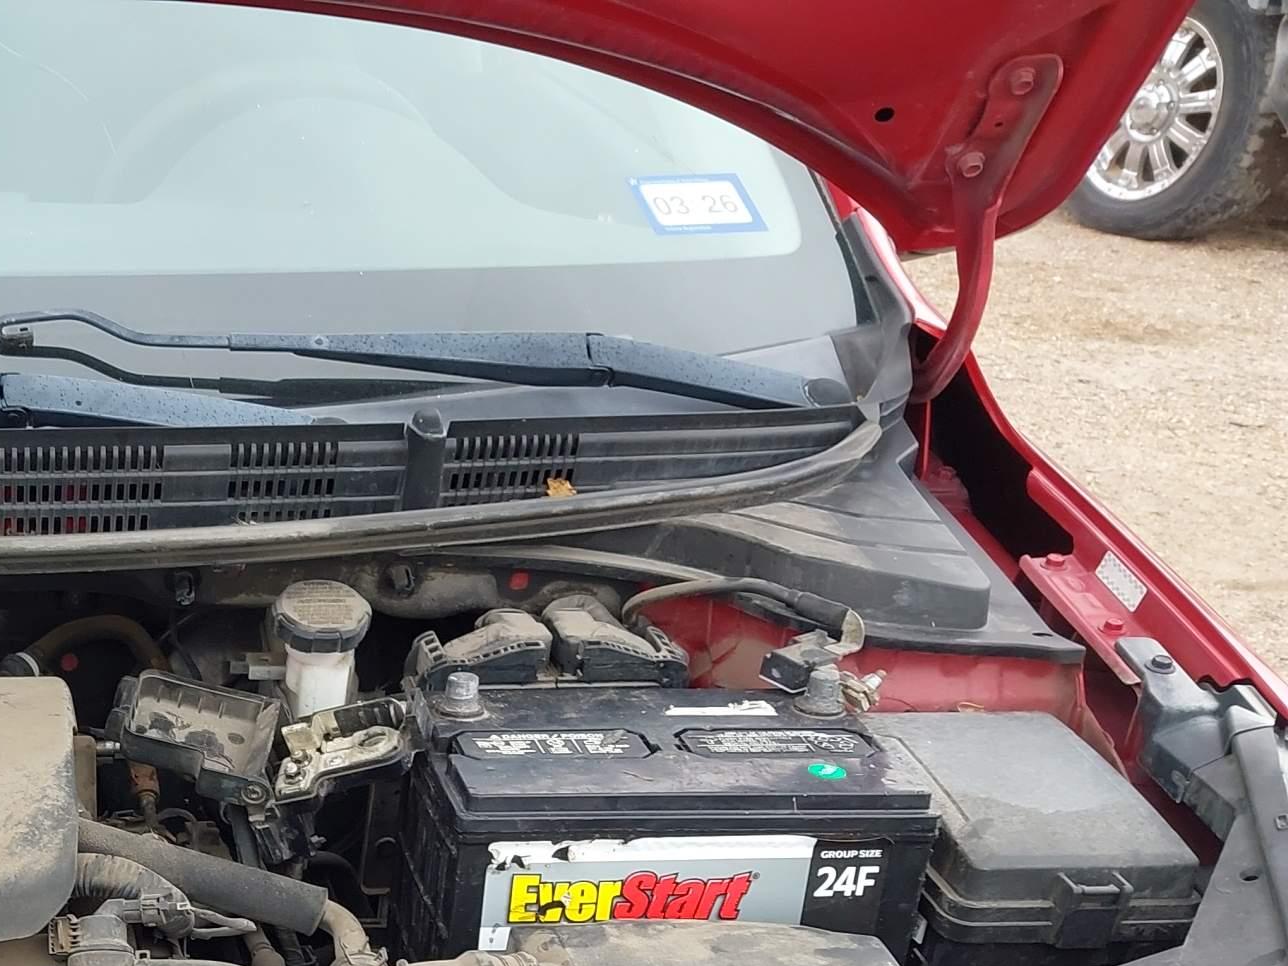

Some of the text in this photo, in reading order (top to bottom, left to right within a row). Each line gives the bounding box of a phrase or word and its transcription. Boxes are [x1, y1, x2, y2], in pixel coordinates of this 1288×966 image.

[653, 195, 738, 215] 03 26
[820, 849, 883, 859] GROUP SIZE
[813, 866, 880, 897] 24F
[507, 870, 752, 923] EverStart
